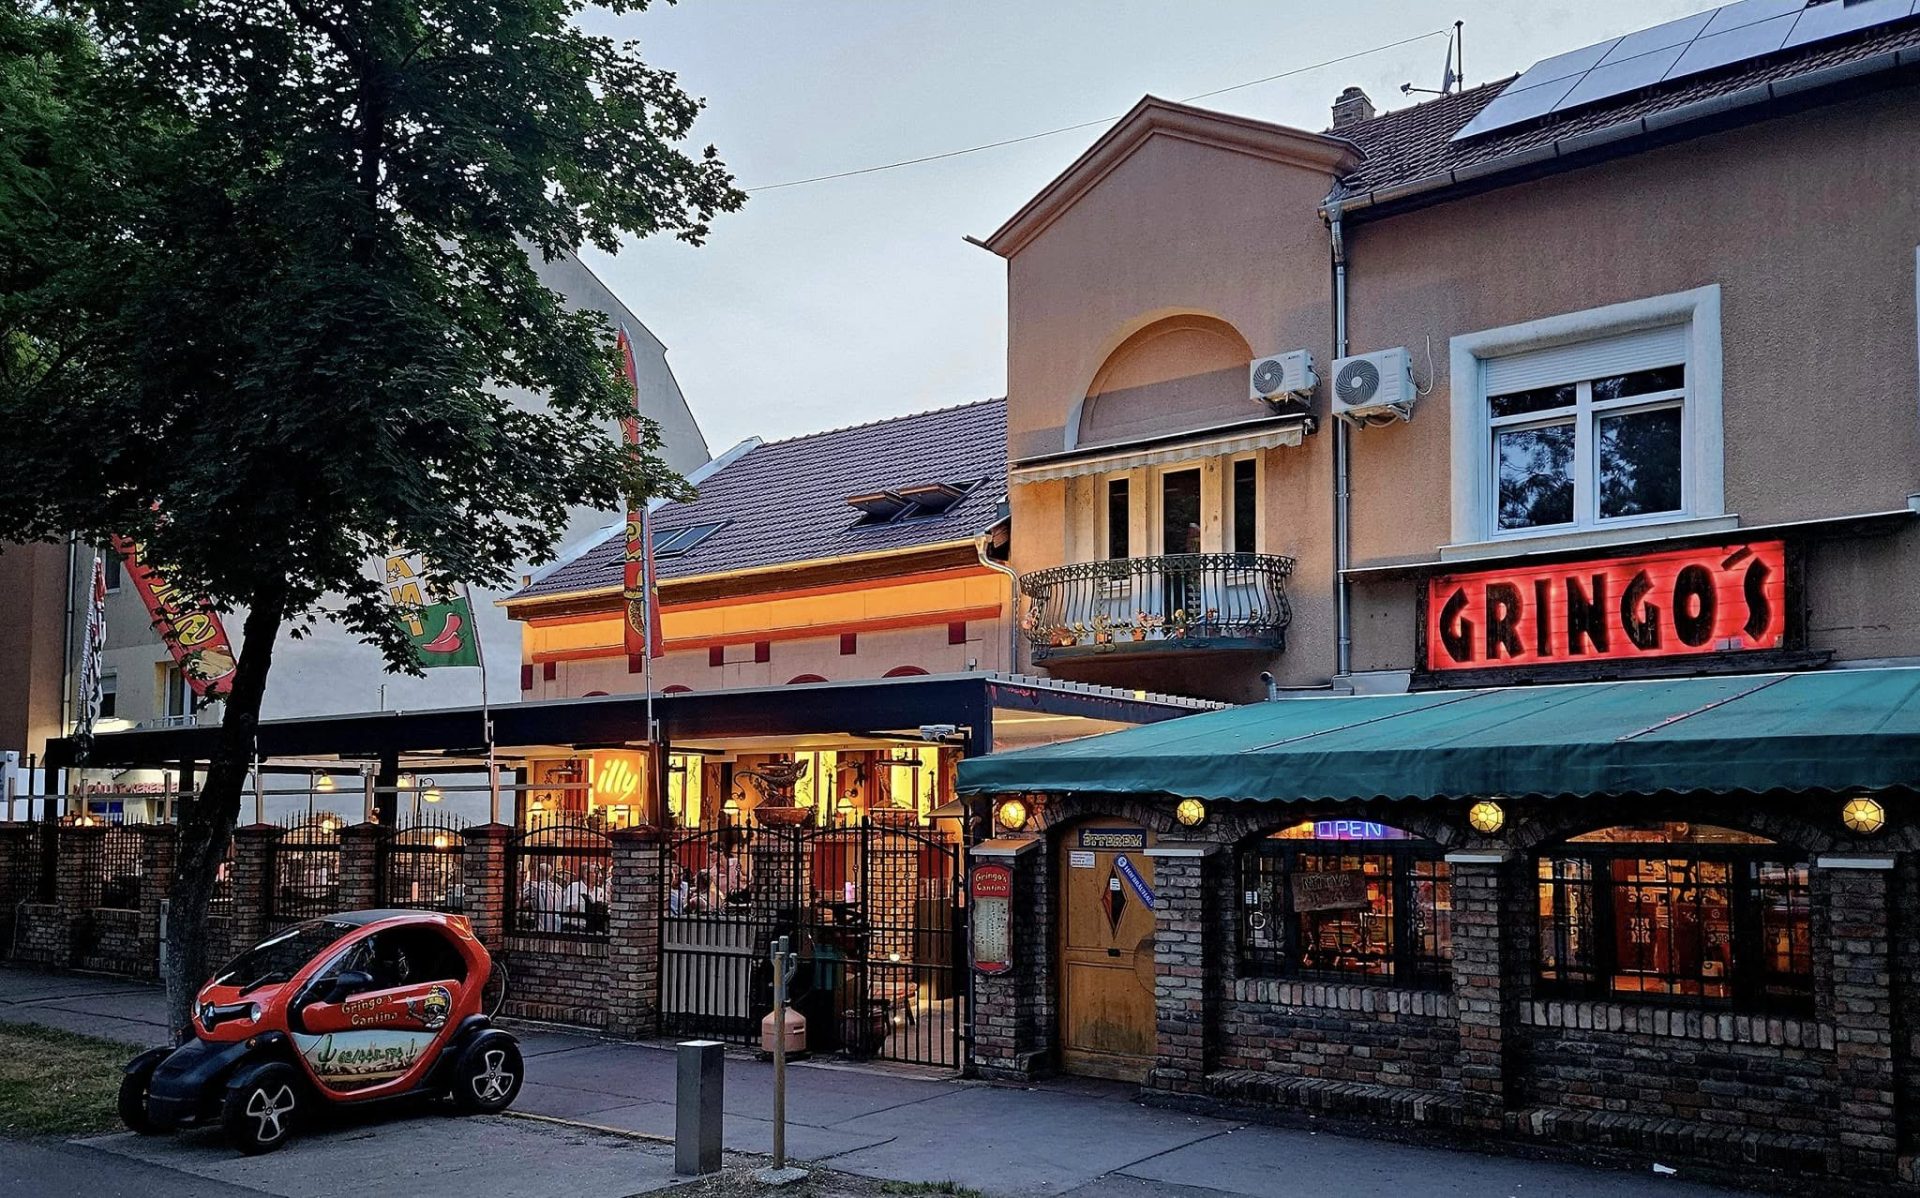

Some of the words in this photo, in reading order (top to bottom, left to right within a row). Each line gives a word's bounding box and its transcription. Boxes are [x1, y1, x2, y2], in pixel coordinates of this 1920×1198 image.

[1439, 545, 1772, 662] GRINGO'S
[597, 759, 639, 801] illy
[1083, 829, 1143, 847] ÉTTEREM
[1318, 820, 1383, 839] OPEN
[976, 882, 1007, 892] Cantina
[341, 994, 393, 1014] Gringo's
[351, 1011, 398, 1026] Cantina
